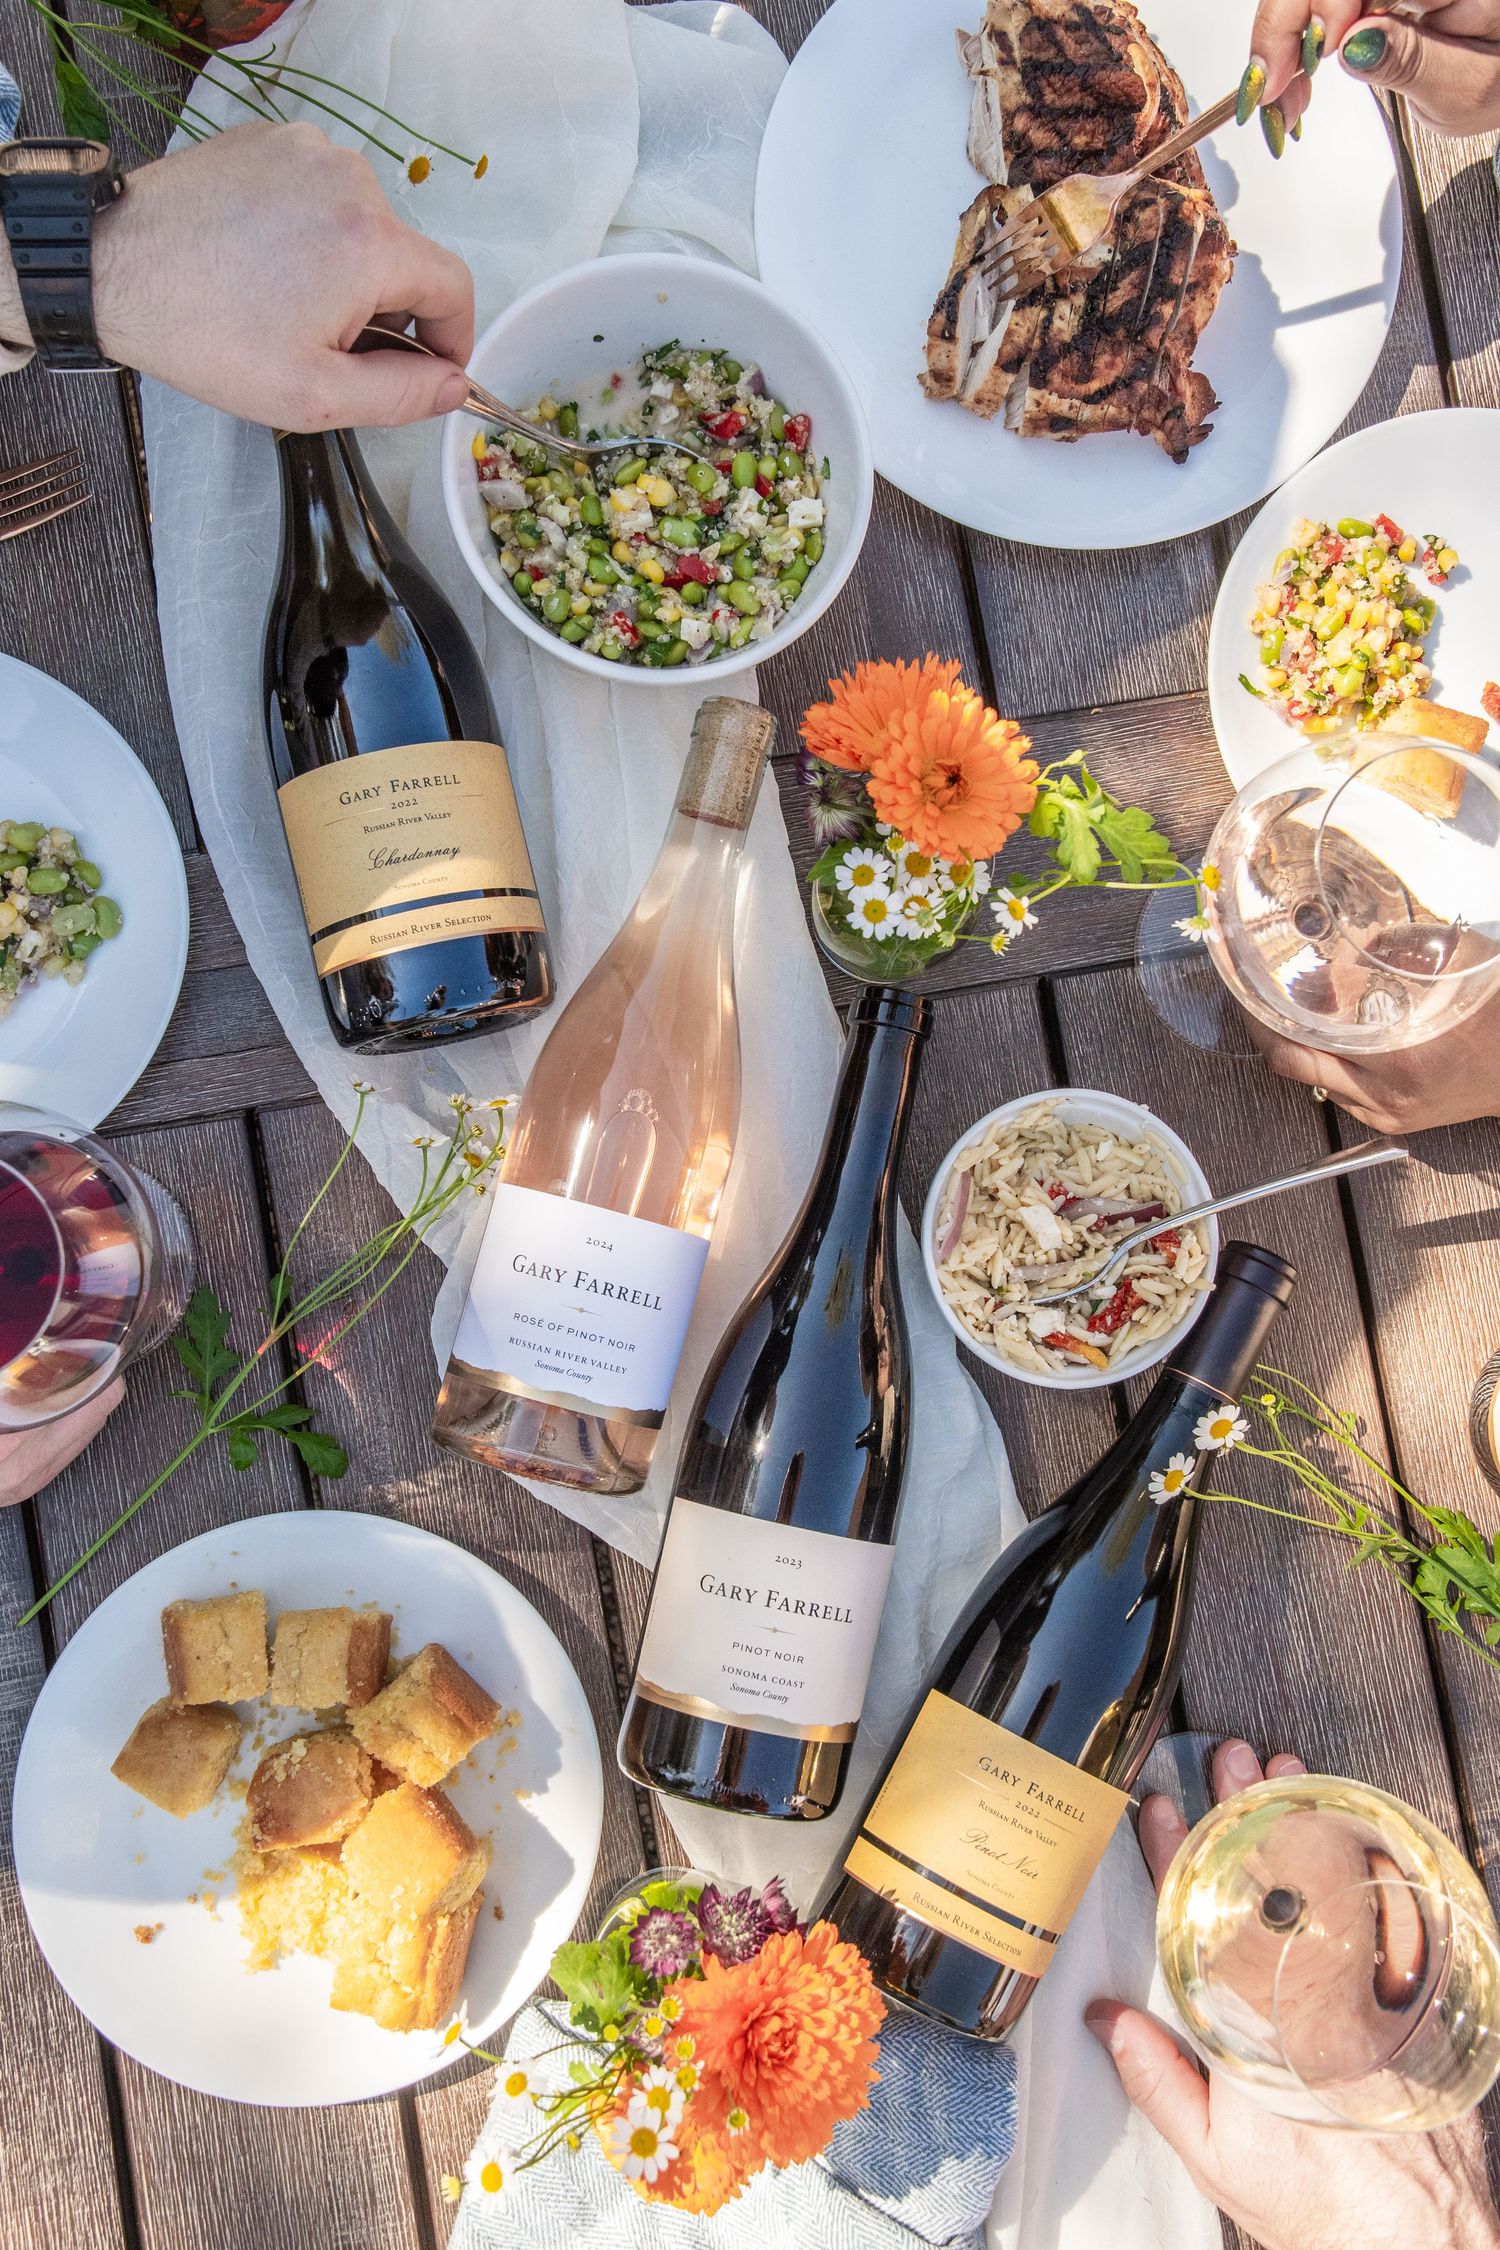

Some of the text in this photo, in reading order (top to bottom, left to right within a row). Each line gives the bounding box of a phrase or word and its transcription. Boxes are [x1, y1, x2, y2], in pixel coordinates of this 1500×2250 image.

[339, 774, 461, 805] GARY FARRELL
[391, 798, 418, 810] 2022
[363, 812, 452, 834] RUSSIAN RIVER VALLEY
[368, 846, 461, 871] Chardonnay
[369, 913, 492, 945] RUSSIAN RIVER SELECTION
[586, 1237, 614, 1253] 2024
[512, 1254, 662, 1311] GARY FARRELL
[513, 1312, 636, 1353] ROSÉ OF PINOT NOIR
[508, 1336, 628, 1375] RUSSIAN RIVER VALLEY
[534, 1359, 594, 1384] Sonoma County
[775, 1555, 803, 1569] 2023
[700, 1574, 853, 1624] GARY FARRELL
[732, 1641, 805, 1664] PINOT NOIR
[721, 1664, 806, 1689] SONOMA COAST
[729, 1682, 790, 1704] Sonoma County
[978, 1756, 1086, 1824] GARY FARRELL
[978, 1799, 1058, 1848] RUSSIAN RIVER VALLEY
[1015, 1801, 1041, 1819] 2022
[959, 1828, 1041, 1880] Pinot Noir
[912, 1891, 1023, 1957] RUSSIAN RIVER SELECTION
